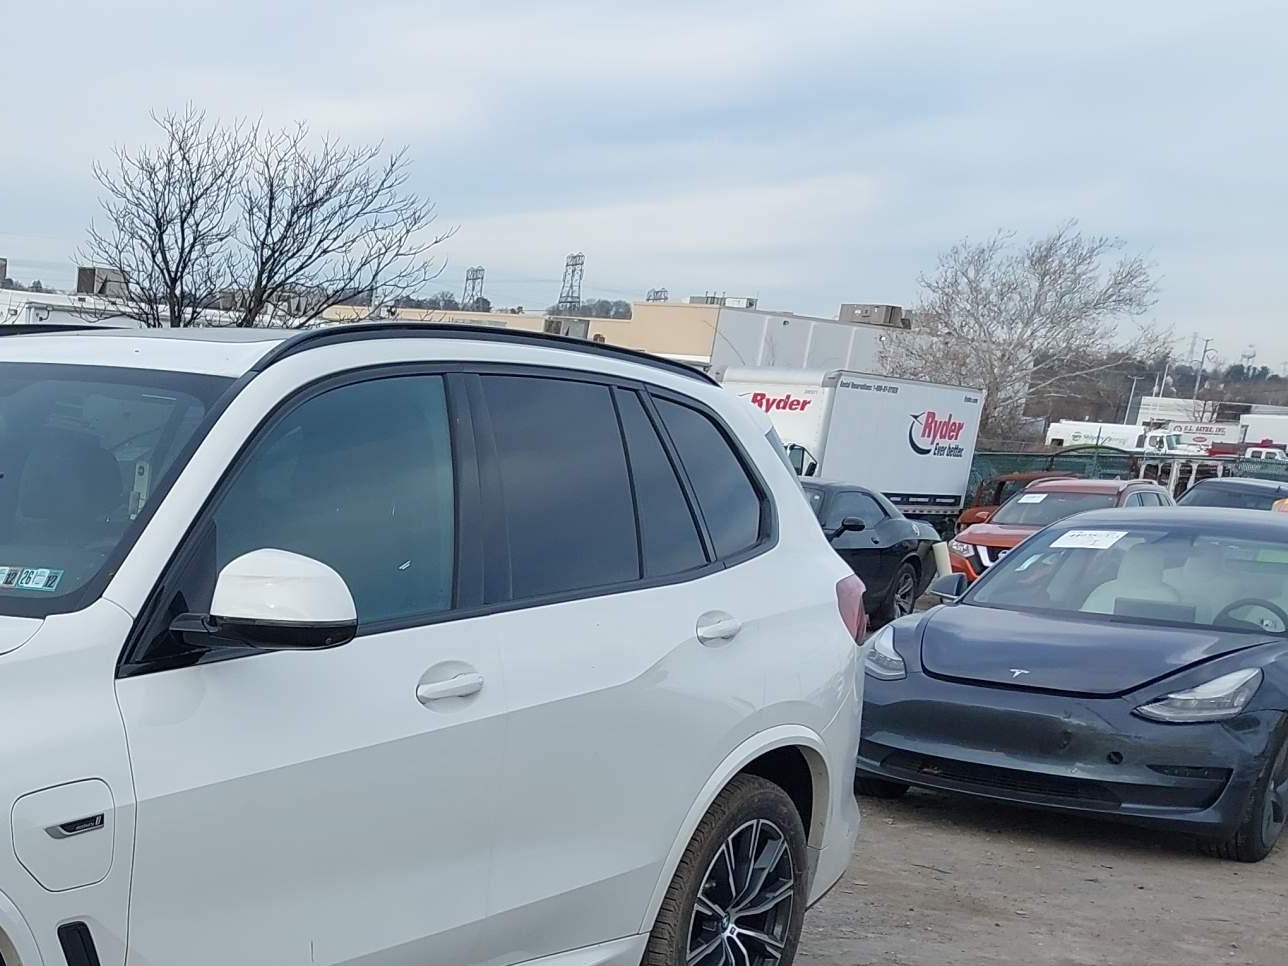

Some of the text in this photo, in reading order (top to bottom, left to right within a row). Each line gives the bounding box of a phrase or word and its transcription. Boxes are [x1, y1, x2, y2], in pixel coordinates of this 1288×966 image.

[751, 392, 812, 414] Ryder
[921, 411, 965, 446] Ryder
[20, 570, 35, 585] 26
